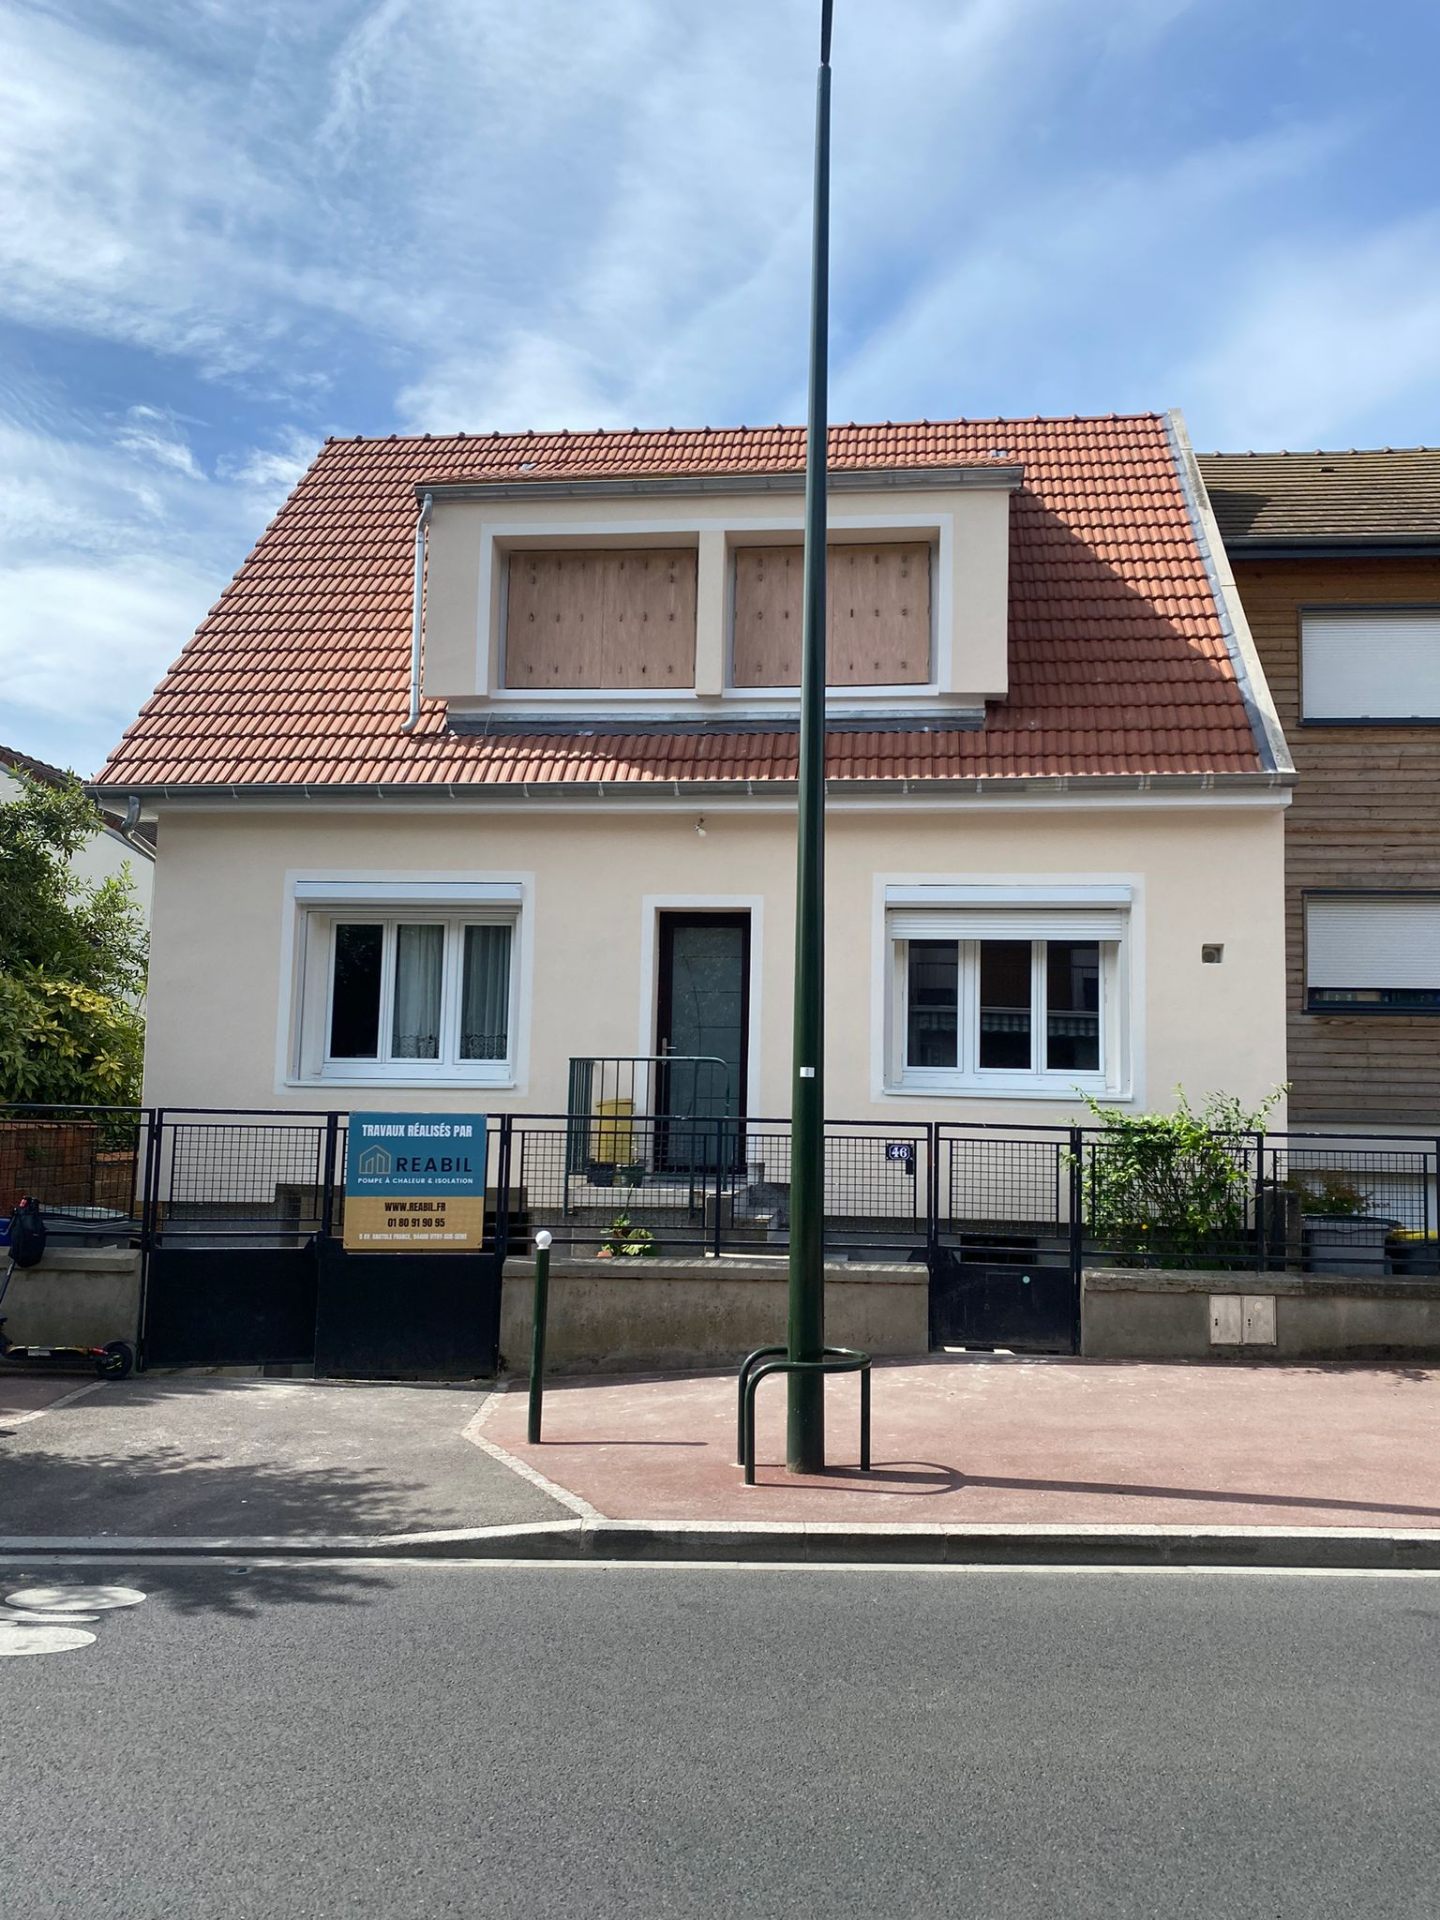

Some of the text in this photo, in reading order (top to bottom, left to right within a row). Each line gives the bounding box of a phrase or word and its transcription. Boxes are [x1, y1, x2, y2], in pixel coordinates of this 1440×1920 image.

[362, 1122, 473, 1137] TRAVAUX RÉALISÉS PAR
[891, 1146, 908, 1158] 46
[396, 1157, 473, 1172] REABIL
[385, 1176, 391, 1184] À
[384, 1202, 446, 1212] WWW.REABIL.FR
[387, 1218, 397, 1227] 01
[411, 1218, 420, 1227] 91
[422, 1218, 433, 1227] 90
[434, 1218, 445, 1227] 95
